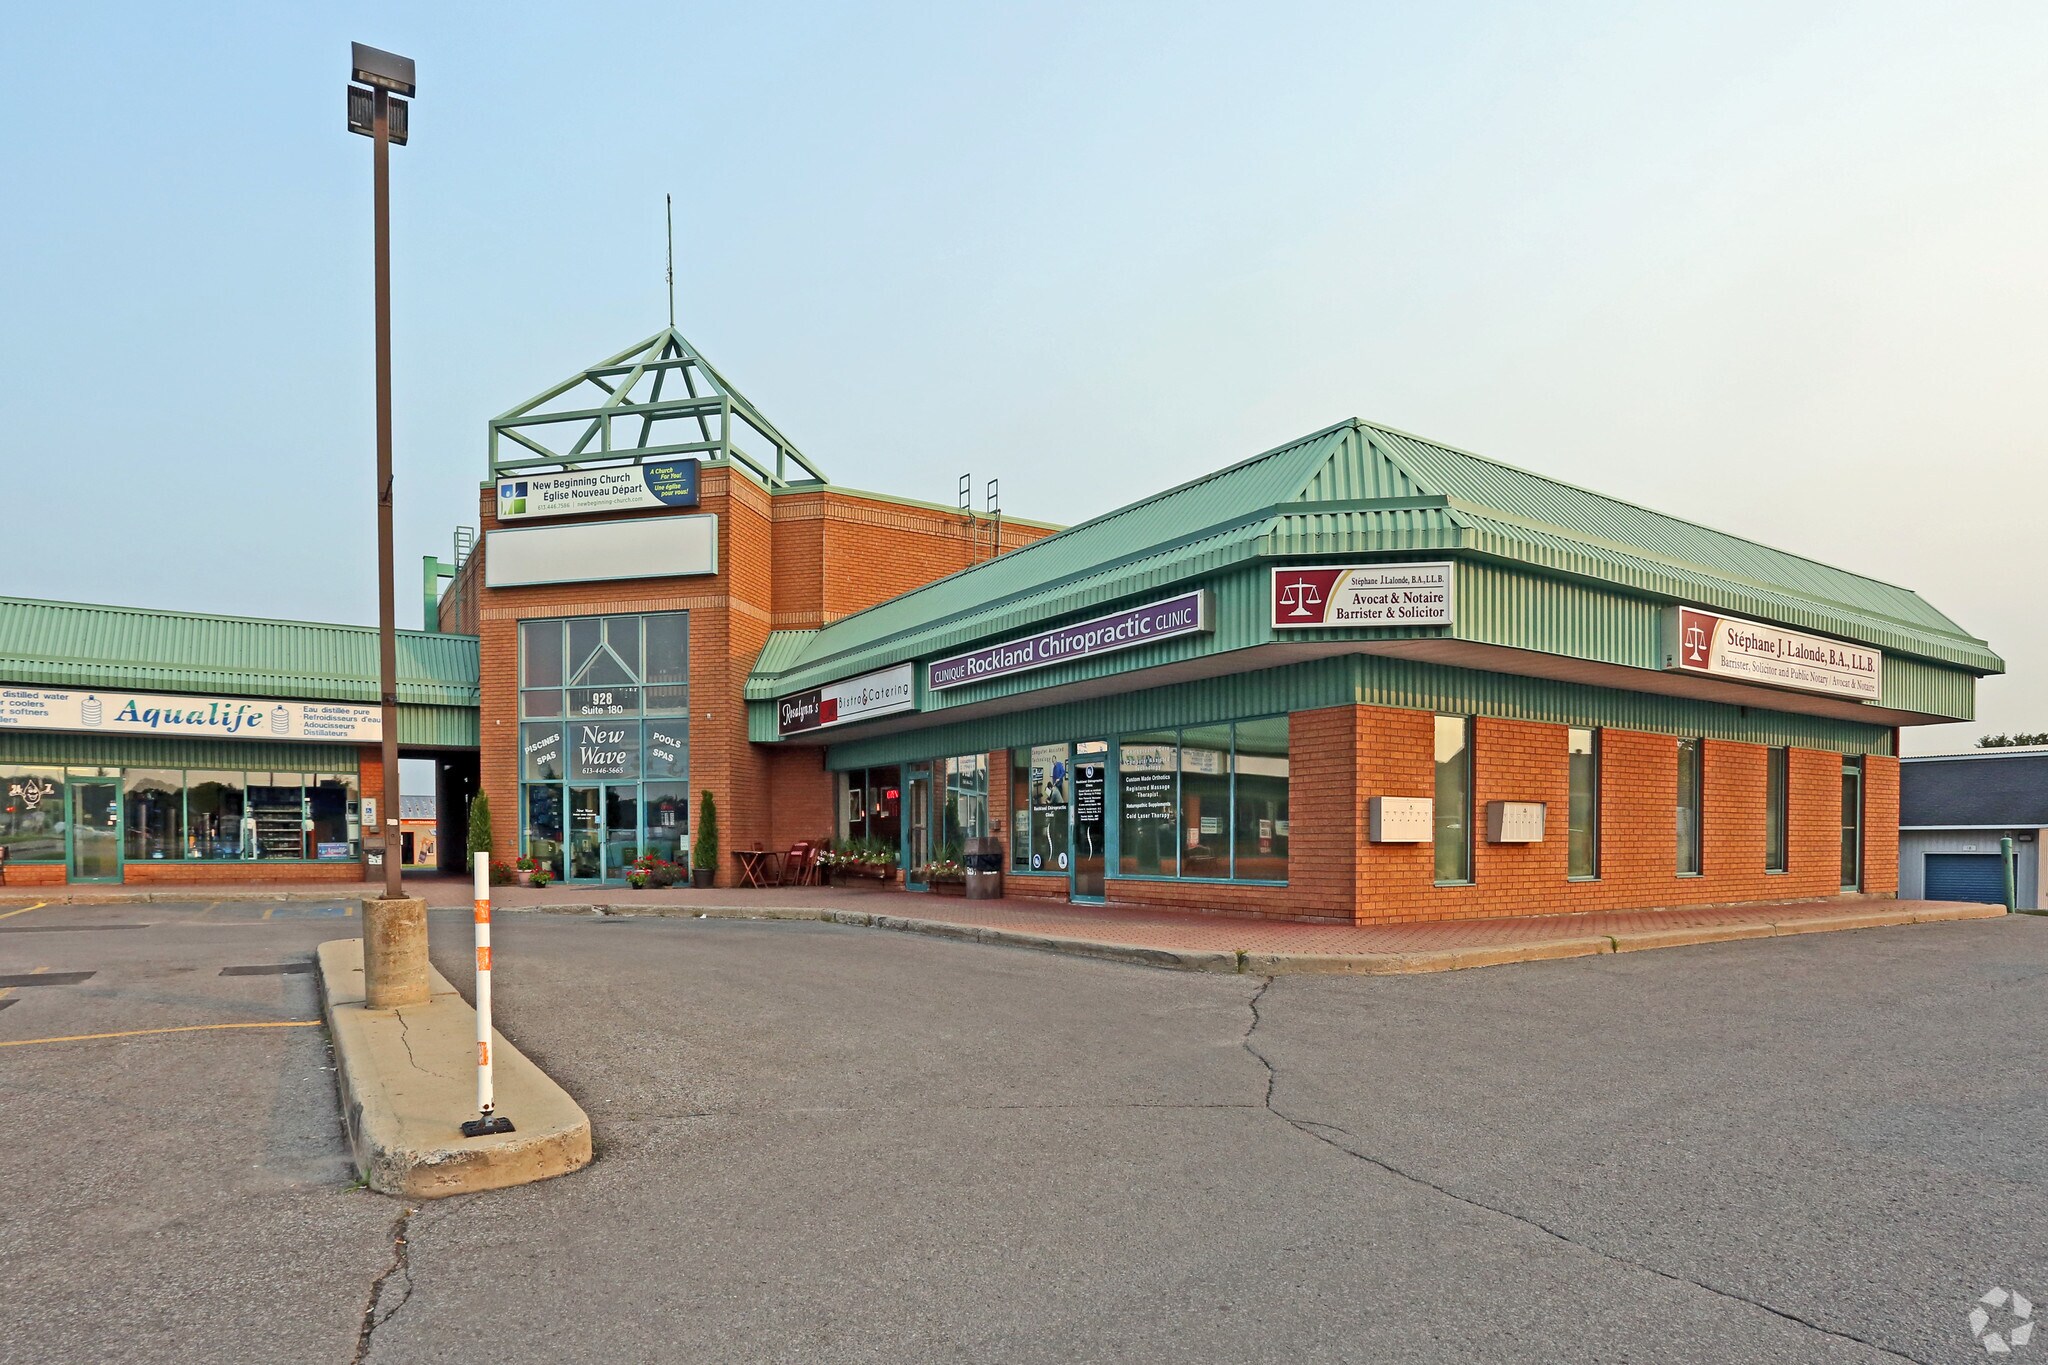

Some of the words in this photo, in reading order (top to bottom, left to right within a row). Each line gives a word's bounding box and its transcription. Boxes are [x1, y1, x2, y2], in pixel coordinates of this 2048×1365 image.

[533, 481, 551, 491] New
[554, 476, 597, 489] Beginning
[600, 473, 630, 484] Church
[543, 490, 569, 502] Église
[572, 488, 609, 500] Nouveau
[612, 484, 642, 496] Départ
[1351, 577, 1377, 586] Stéphane
[1353, 593, 1388, 604] Avocat
[1391, 592, 1399, 604] &
[1403, 591, 1443, 604] Notaire
[1336, 607, 1382, 619] Barrister
[1386, 607, 1395, 618] &
[1398, 606, 1444, 618] Solicitor
[934, 665, 965, 683] CLINIQUE
[967, 642, 1033, 676] Rockland
[1038, 613, 1151, 659] Chiropractic
[1155, 608, 1192, 631] CLINIC
[1727, 628, 1775, 653] Stéphane
[1777, 639, 1785, 658] J.
[1787, 641, 1827, 666] Lalonde,
[1829, 649, 1850, 670] B.A.,
[1752, 661, 1777, 676] Solicitor
[1779, 667, 1789, 678] and
[1790, 668, 1809, 681] Public
[1810, 671, 1828, 686] Notary
[1832, 676, 1850, 688] Avocat
[1857, 680, 1875, 692] Notaire
[3, 690, 39, 699] distilled
[592, 693, 612, 705] 928
[10, 708, 49, 716] softners
[114, 699, 264, 733] Aqualife
[581, 705, 603, 715] Suite
[608, 705, 624, 714] 180
[303, 714, 358, 722] Refroidisseurs
[304, 721, 355, 730] Adoucisseurs
[581, 725, 625, 744] New
[653, 732, 682, 749] POOLS
[525, 733, 560, 755] PISCINES
[536, 751, 557, 766] SPAS
[579, 746, 627, 765] Wave
[653, 748, 674, 762] SPAS
